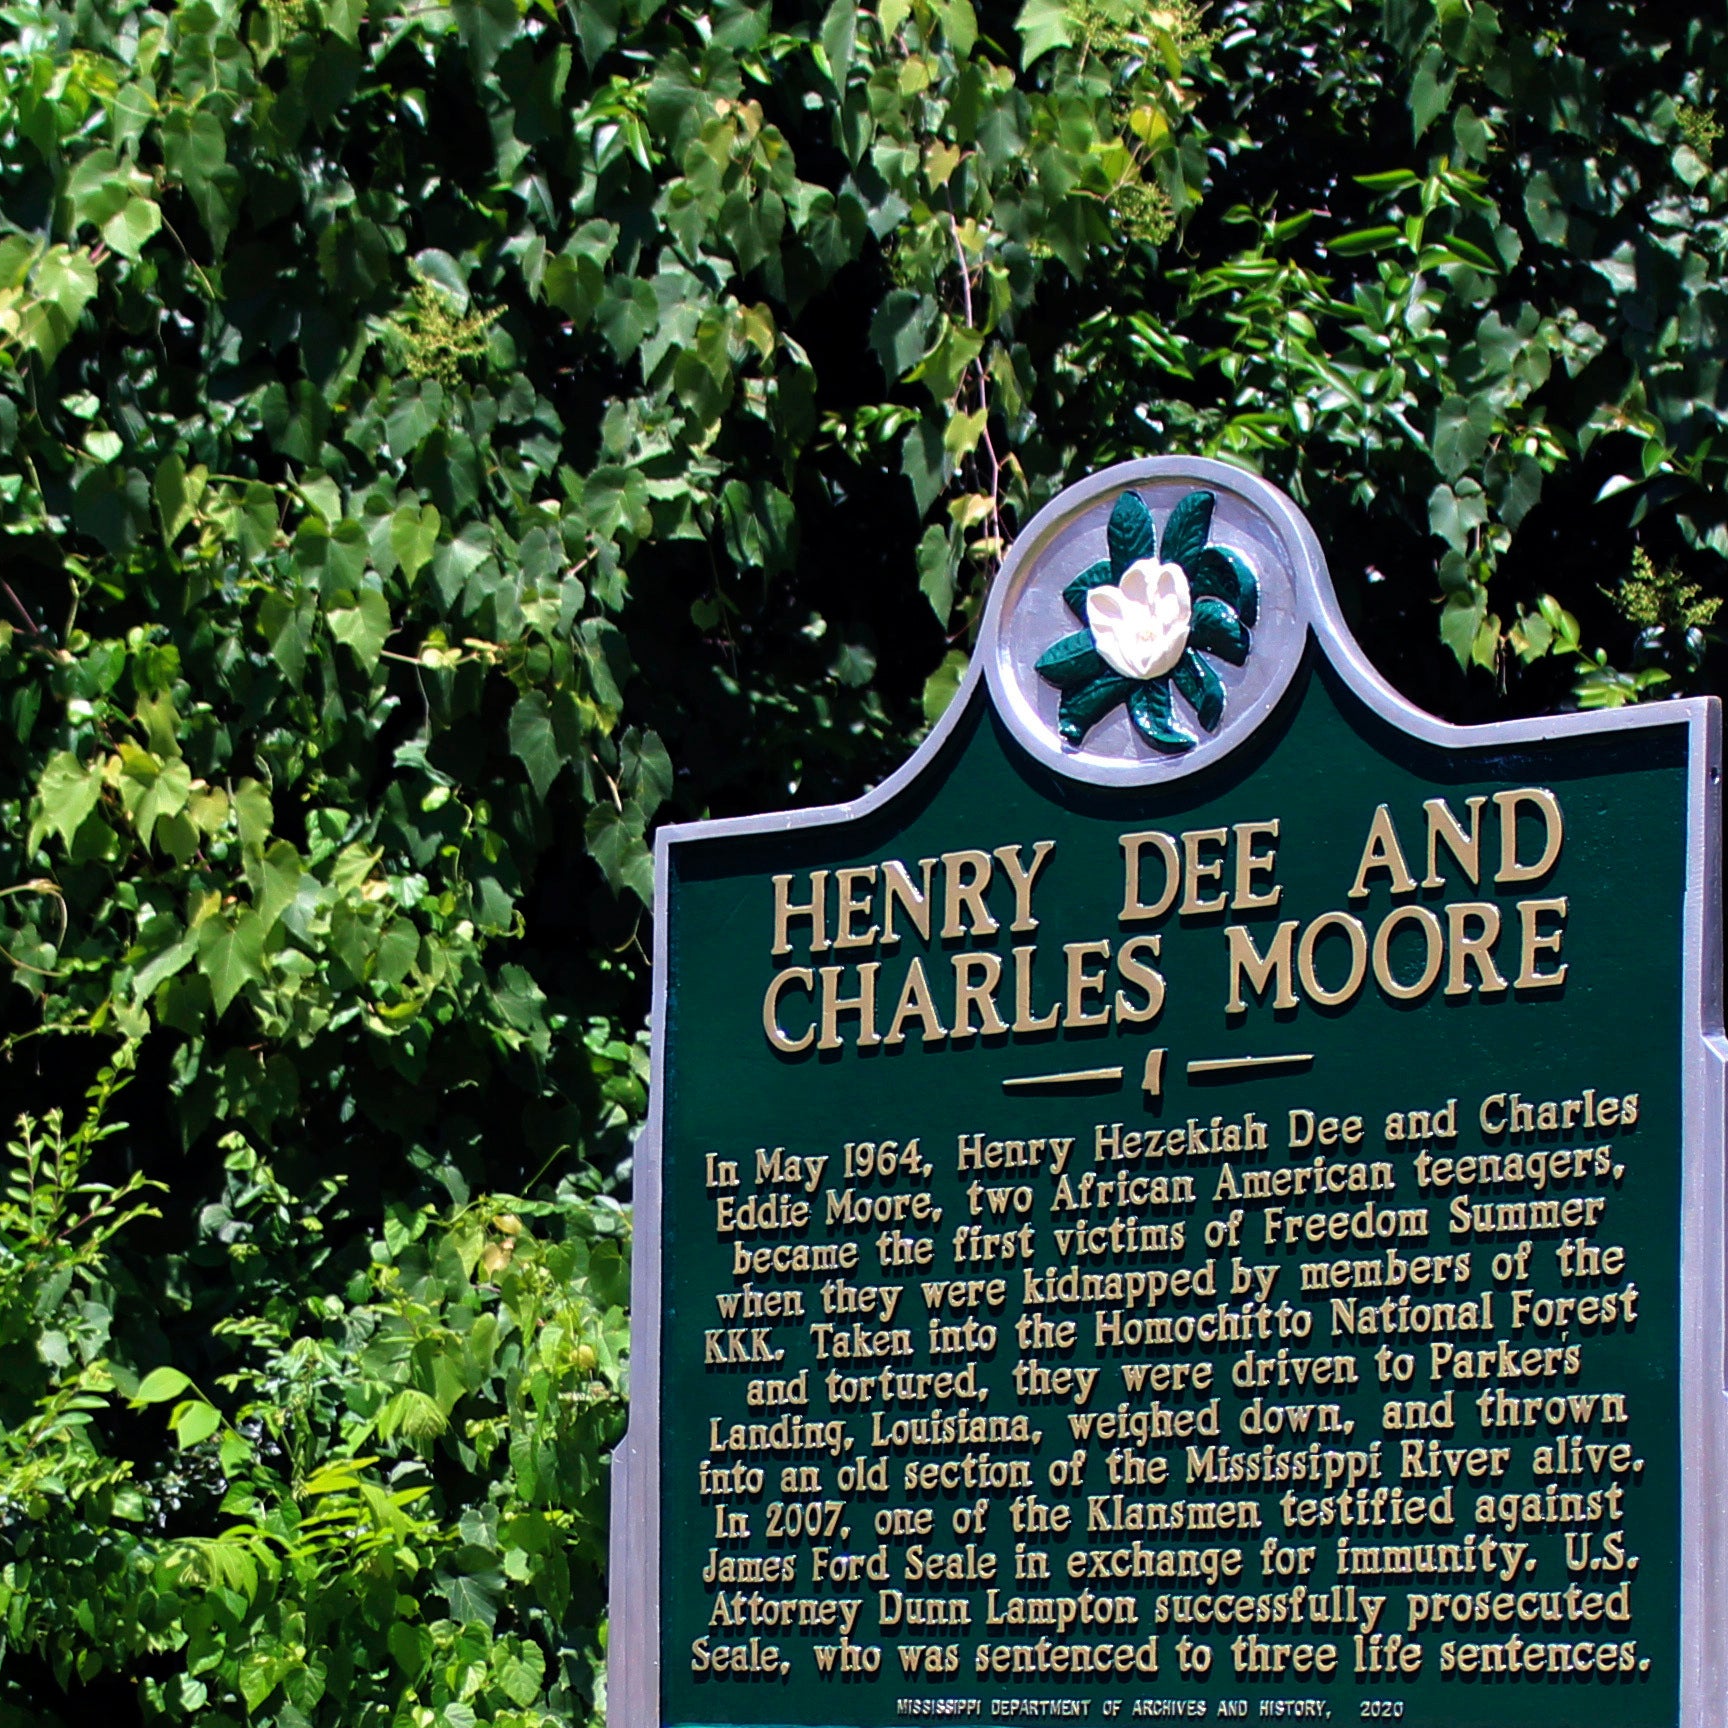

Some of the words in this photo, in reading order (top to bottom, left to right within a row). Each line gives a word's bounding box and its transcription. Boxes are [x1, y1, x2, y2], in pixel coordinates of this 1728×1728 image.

[770, 840, 1057, 955] HENRY
[1117, 818, 1284, 921] DEE
[1347, 786, 1563, 898] AND
[763, 934, 1167, 1052] CHARLES
[1223, 895, 1569, 1013] MOORE
[705, 1152, 741, 1188] In
[754, 1147, 829, 1193] May
[843, 1137, 933, 1178] 1964,
[957, 1132, 1076, 1175] Henry
[1094, 1112, 1269, 1162] Hezekiah
[1288, 1109, 1365, 1148] Dee
[1384, 1098, 1459, 1141] and
[1479, 1088, 1639, 1134] Charles
[716, 1192, 810, 1232] Eddie
[825, 1187, 943, 1225] Moore,
[966, 1179, 1033, 1216] two
[1049, 1169, 1197, 1212] African
[1212, 1155, 1396, 1201] American
[1413, 1144, 1625, 1190] teenagers,
[732, 1240, 860, 1275] became
[875, 1229, 934, 1266] the
[952, 1221, 1036, 1262] first
[1053, 1215, 1186, 1256] victims
[1204, 1208, 1244, 1248] of
[1263, 1200, 1429, 1245] Freedom
[1449, 1193, 1606, 1234] Summer
[715, 1281, 805, 1319] when
[819, 1278, 904, 1323] they
[920, 1278, 1006, 1309] were
[1022, 1258, 1217, 1309] kidnapped
[1230, 1256, 1281, 1303] by
[1299, 1248, 1471, 1291] members
[1491, 1240, 1533, 1281] of
[1555, 1236, 1626, 1277] the
[704, 1327, 785, 1364] KKK.
[809, 1322, 915, 1360] Taken
[928, 1315, 998, 1354] into
[1014, 1312, 1076, 1350] the
[1094, 1300, 1312, 1347] Homochitto
[1329, 1290, 1495, 1336] National
[1510, 1282, 1639, 1329] Forest
[746, 1368, 810, 1406] and
[824, 1361, 989, 1404] tortured,
[1012, 1358, 1101, 1405] they
[1120, 1362, 1214, 1392] were
[1231, 1347, 1359, 1388] driven
[1374, 1343, 1415, 1382] to
[709, 1412, 855, 1457] Landing,
[870, 1407, 1043, 1447] Louisiana,
[1067, 1397, 1221, 1448] weighed
[1239, 1396, 1355, 1435] down,
[1382, 1397, 1455, 1430] and
[1475, 1387, 1629, 1427] thrown
[699, 1459, 765, 1495] into
[780, 1466, 823, 1493] an
[837, 1455, 890, 1491] old
[904, 1452, 1034, 1490] section
[1048, 1448, 1087, 1487] of
[1105, 1446, 1170, 1485] the
[1185, 1440, 1383, 1489] Mississippi
[1399, 1438, 1511, 1478] River
[1532, 1434, 1645, 1475] alive.
[715, 1503, 751, 1539] In
[765, 1499, 851, 1540] 2007,
[874, 1508, 933, 1536] one
[952, 1498, 990, 1534] of
[1009, 1494, 1072, 1533] the
[1087, 1493, 1263, 1532] Klansmen
[1279, 1485, 1455, 1527] testified
[1475, 1481, 1624, 1532] against
[702, 1547, 797, 1583] James
[811, 1544, 891, 1582] Ford
[904, 1543, 997, 1580] Seale
[1014, 1542, 1051, 1579] in
[1066, 1540, 1244, 1586] exchange
[1259, 1536, 1317, 1575] for
[1336, 1533, 1537, 1582] immunity.
[1564, 1529, 1640, 1571] U.S.
[708, 1590, 863, 1635] Attorney
[878, 1589, 972, 1625] Dunn
[985, 1587, 1139, 1633] Lampton
[1154, 1584, 1387, 1635] successfully
[1406, 1580, 1631, 1632] prosecuted
[691, 1634, 791, 1675] Seale,
[813, 1636, 882, 1672] who
[897, 1643, 959, 1673] was
[975, 1635, 1160, 1673] sentenced
[1174, 1634, 1212, 1672] to
[1230, 1633, 1339, 1672] three
[1353, 1633, 1423, 1673] life
[1440, 1633, 1651, 1673] sentences.
[897, 1698, 982, 1715] MISSISSIPPI
[991, 1699, 1091, 1716] DEPARTMENT
[1102, 1699, 1122, 1717] OF
[1132, 1699, 1207, 1717] ARCHIVES
[1217, 1699, 1248, 1717] AND
[1259, 1699, 1331, 1719] HISTORY,
[1360, 1700, 1404, 1718] 2020
